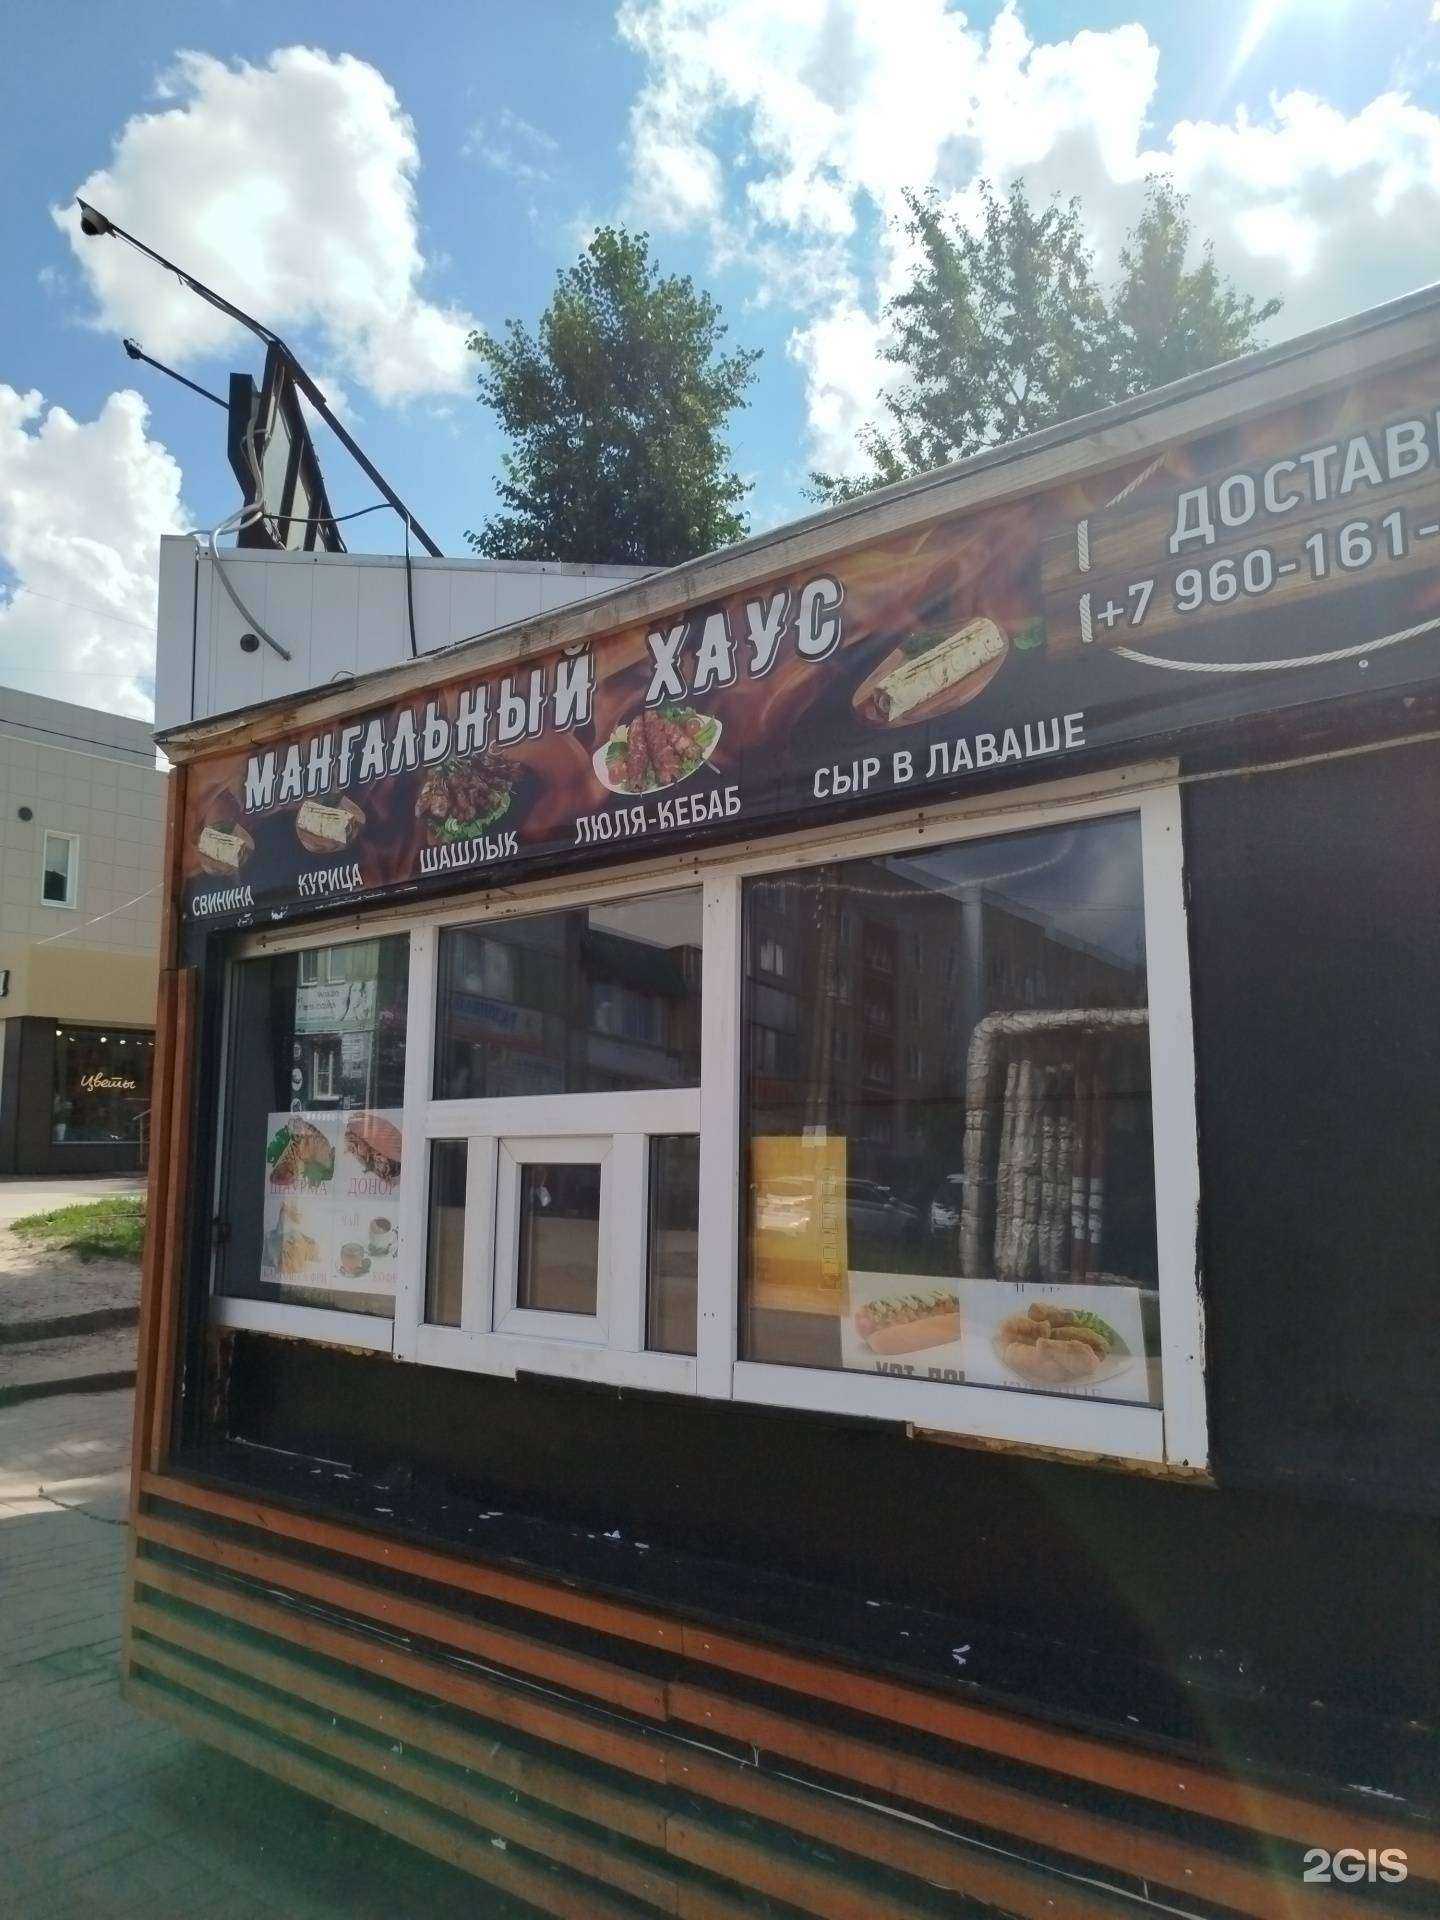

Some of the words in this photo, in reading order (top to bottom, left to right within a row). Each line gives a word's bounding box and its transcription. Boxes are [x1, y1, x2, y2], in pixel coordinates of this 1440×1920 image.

[1170, 411, 1440, 553] ДОСТАВ
[1098, 579, 1154, 631] +7
[245, 642, 596, 814] МАНГАЛЬНЫЙ
[645, 575, 845, 709] ХАУС
[813, 757, 880, 799] СЫР
[893, 751, 914, 785] В
[925, 713, 1086, 779] ЛАВАШЕ
[574, 786, 742, 845] ЛЮЛЯ-КЕБАБ
[419, 831, 519, 873] ШАШЛЫК
[192, 885, 254, 916] СВИНИНА
[298, 863, 364, 896] КУРИЦА
[80, 1071, 136, 1092] Цветы
